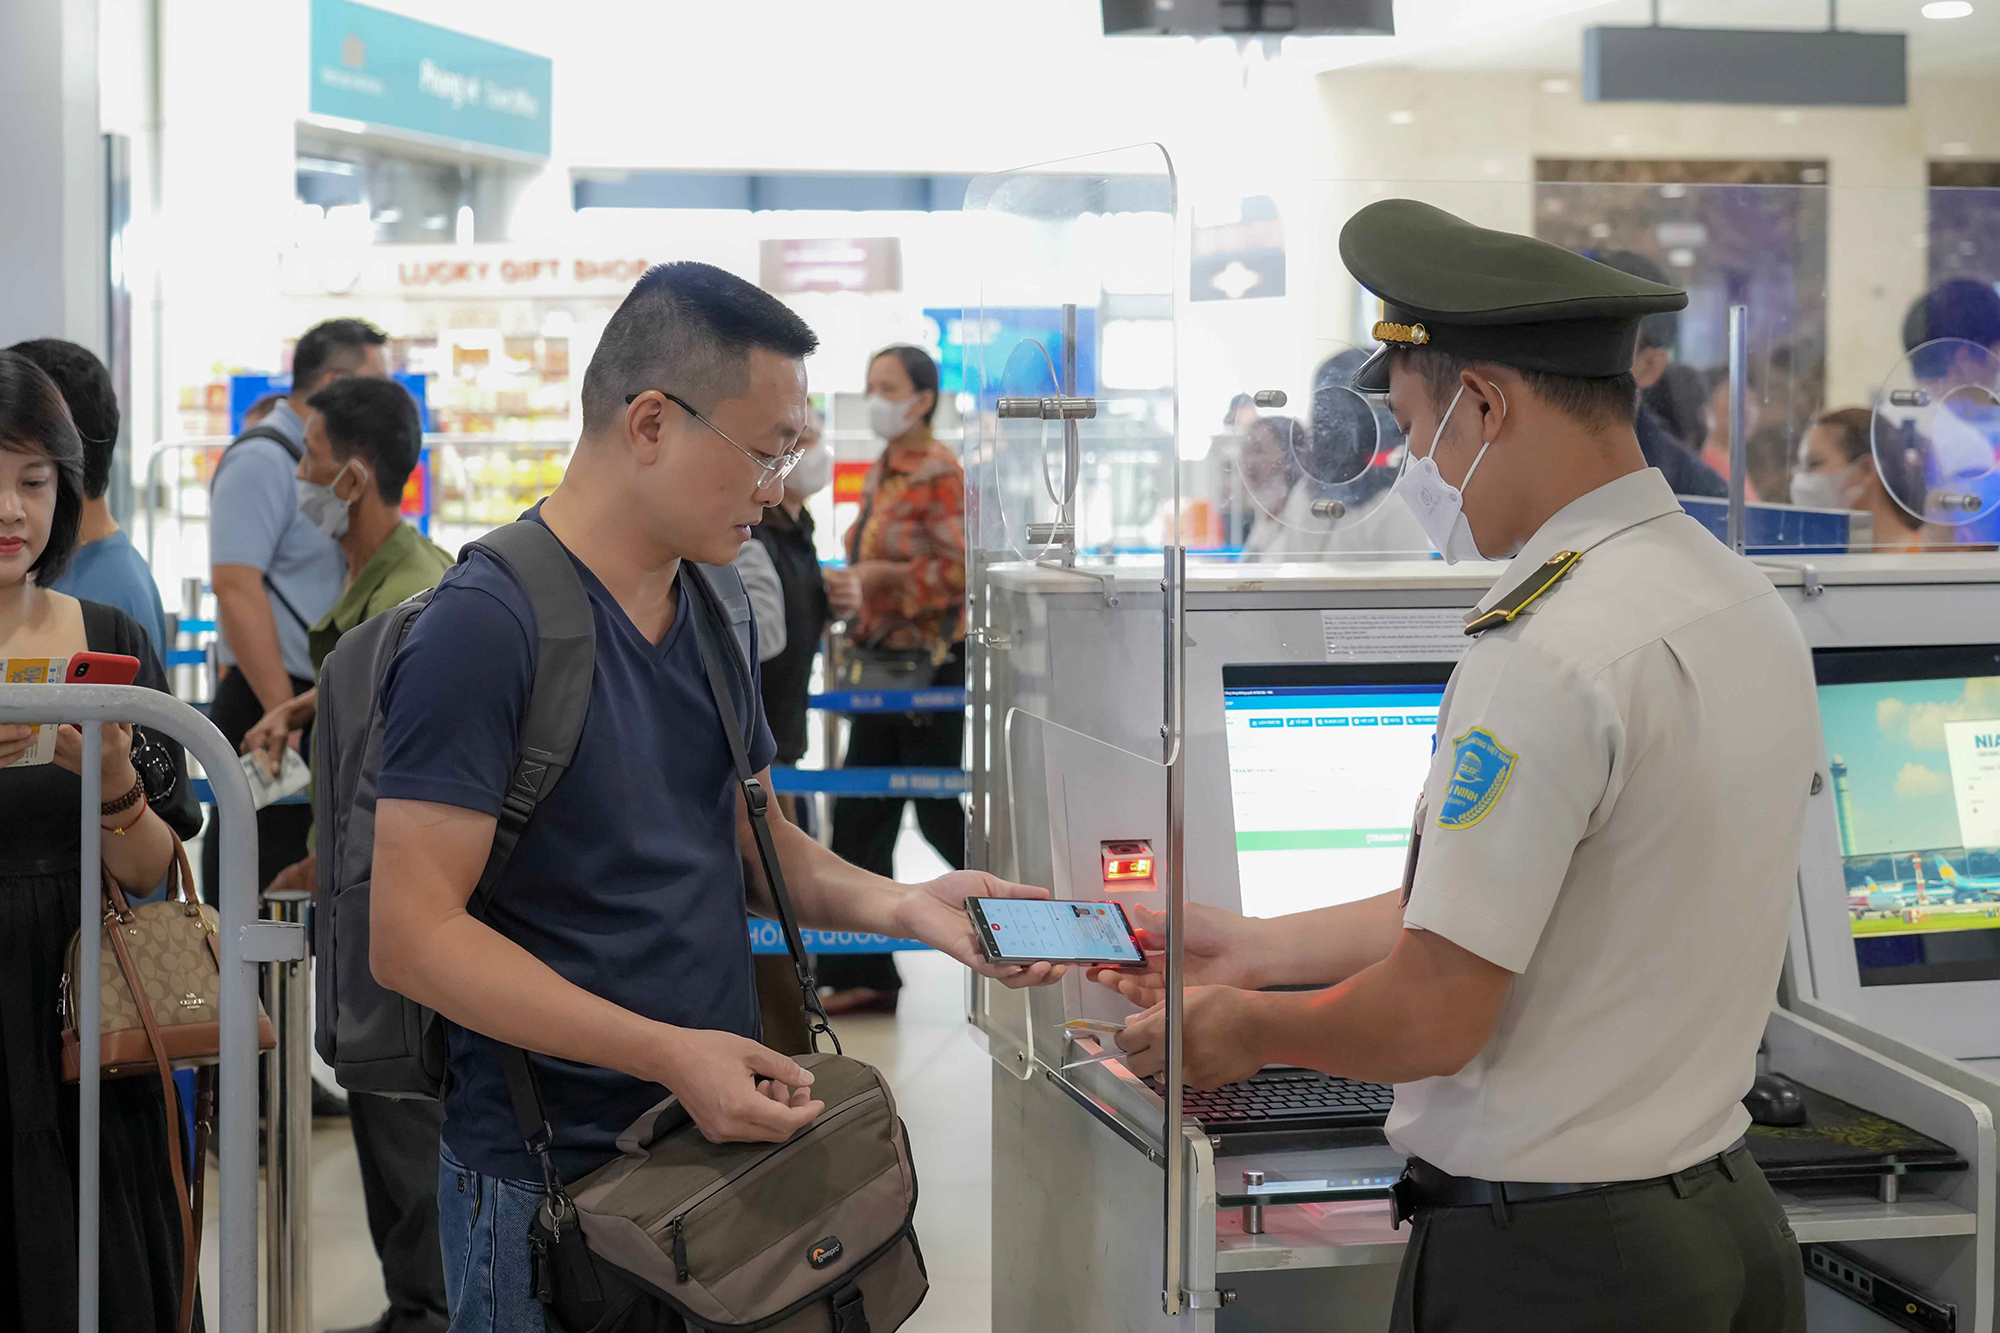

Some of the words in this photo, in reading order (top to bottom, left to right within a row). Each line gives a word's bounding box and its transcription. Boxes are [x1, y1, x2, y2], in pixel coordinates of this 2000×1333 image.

[398, 260, 490, 287] LUCKY
[501, 258, 560, 285] GIFT
[1454, 784, 1479, 803] NINH
